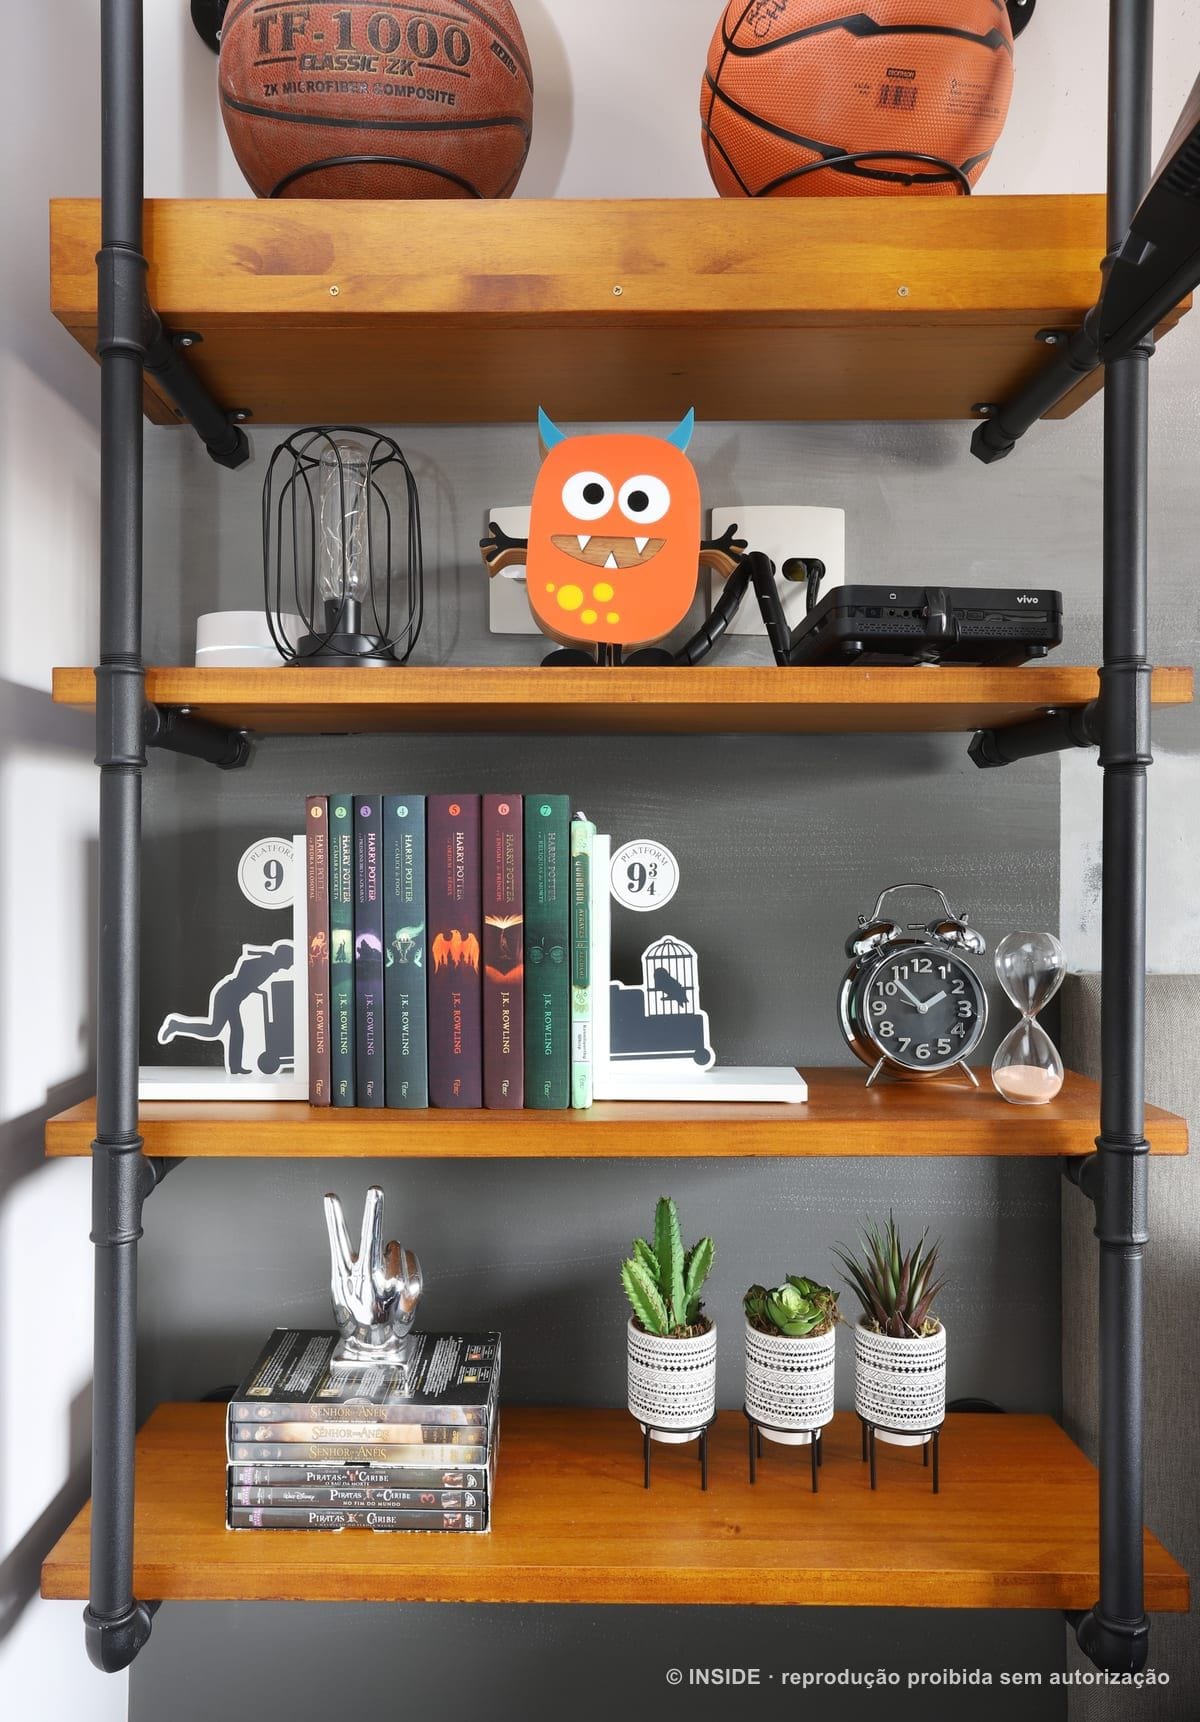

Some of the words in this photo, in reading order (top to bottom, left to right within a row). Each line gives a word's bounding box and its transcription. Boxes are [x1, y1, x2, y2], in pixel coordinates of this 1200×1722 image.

[252, 10, 473, 68] TF-1000
[299, 53, 378, 74] CLASSIC
[383, 55, 417, 77] ZK
[263, 83, 279, 97] ZK
[282, 80, 370, 95] MICROFIBER
[373, 82, 457, 106] COMPOSITE
[1016, 595, 1039, 604] vivo
[316, 834, 324, 865] HARRY
[342, 835, 350, 865] HARRY
[368, 833, 376, 864] HARRY
[405, 834, 413, 865] HARRY
[456, 832, 464, 863] HARRY
[506, 834, 514, 865] HARRY
[548, 832, 556, 865] HARRY
[620, 847, 668, 866] PLATFORM
[263, 860, 284, 892] 9
[368, 866, 376, 902] POTTER
[405, 868, 413, 903] POTTER
[456, 865, 464, 901] POTTER
[506, 867, 514, 903] POTTER
[548, 866, 556, 902] POTTER
[627, 862, 647, 893] 9
[342, 868, 350, 904] POTTER
[891, 966, 909, 980] 11
[911, 958, 933, 973] 12
[938, 966, 946, 979] 1
[876, 981, 898, 996] 10
[951, 979, 965, 994] 2
[315, 993, 323, 1008] J.K.
[338, 993, 347, 1008] J.K.
[364, 994, 373, 1009] J.K.
[400, 994, 408, 1009] J.K.
[452, 992, 461, 1007] J.K.
[501, 992, 509, 1007] J.K.
[543, 994, 551, 1009] J.K.
[871, 1001, 887, 1016] 9
[958, 1001, 972, 1018] 3
[316, 1010, 324, 1054] ROWLING
[340, 1010, 348, 1055] ROWLING
[366, 1011, 374, 1056] ROWLING
[401, 1011, 409, 1056] ROWLING
[453, 1010, 461, 1055] ROWLING
[502, 1009, 510, 1054] ROWLING
[544, 1011, 552, 1056] ROWLING
[879, 1021, 895, 1037] 8
[951, 1022, 966, 1038] 4
[898, 1038, 912, 1053] 7
[915, 1043, 931, 1059] 6
[937, 1038, 952, 1054] 5
[310, 1405, 351, 1419] SENHOR
[309, 1445, 350, 1459] SENHOR
[306, 1472, 342, 1482] PIRATAS
[358, 1471, 389, 1482] CARIBE
[330, 1489, 362, 1501] PIRATAS
[383, 1489, 411, 1501] CARIBE
[309, 1512, 345, 1523] PIRATAS
[367, 1512, 397, 1524] CARIBE
